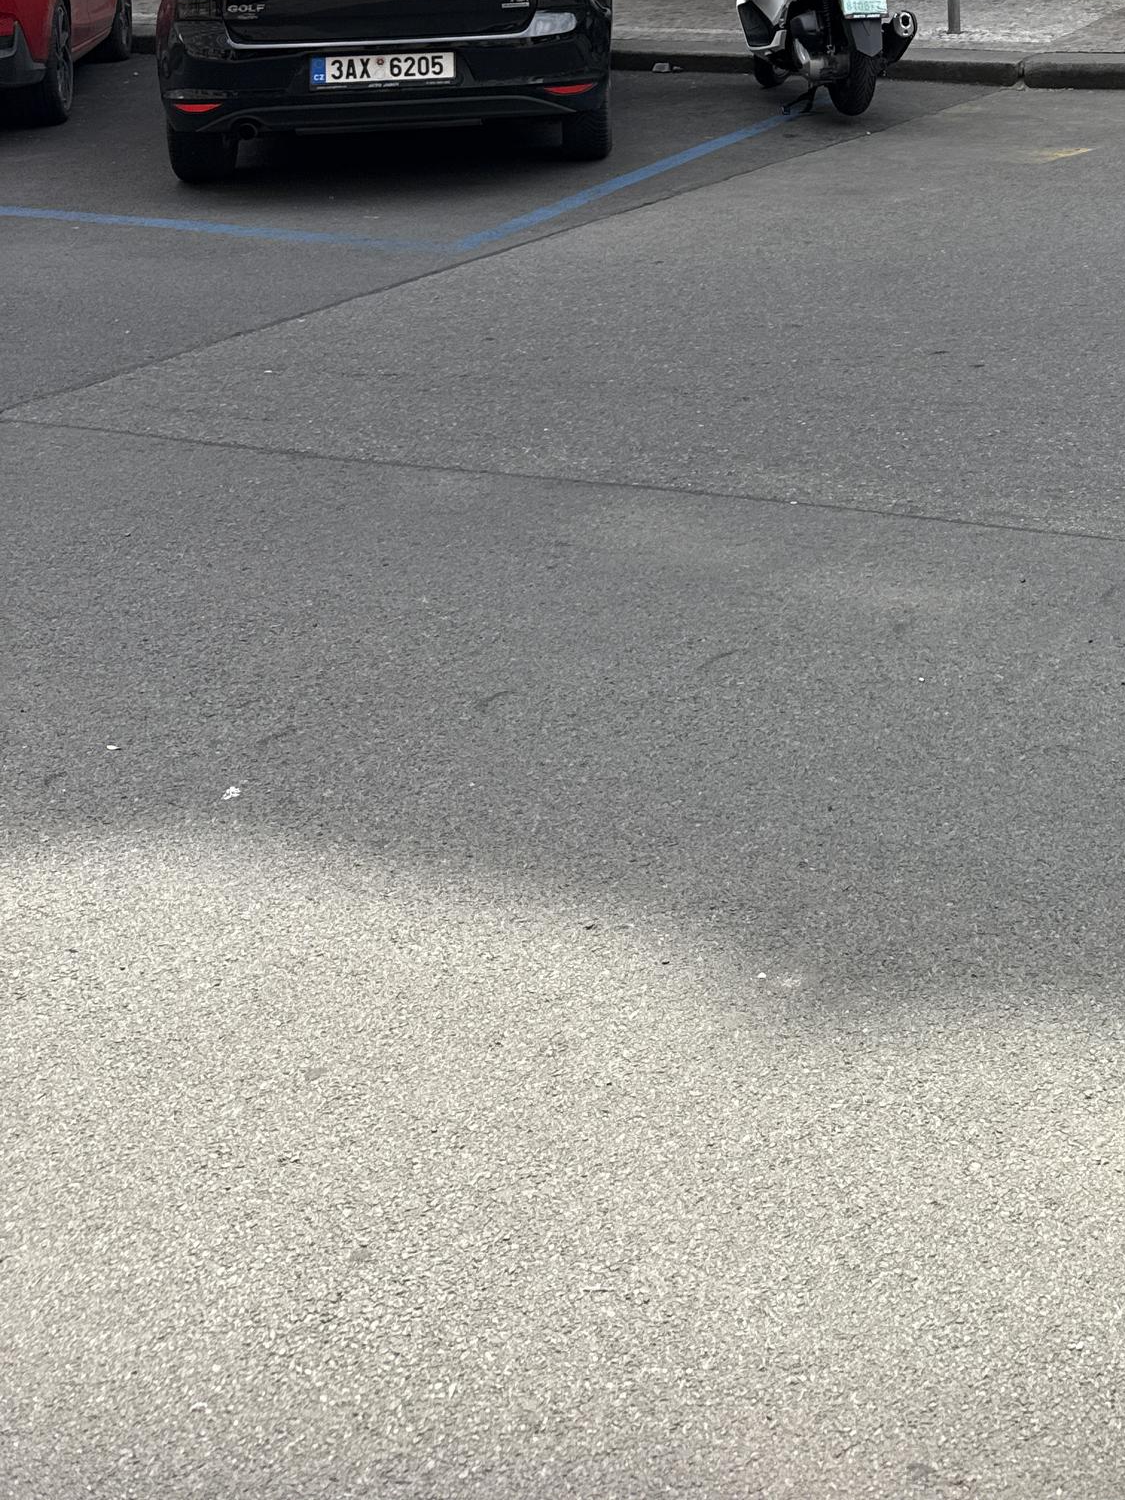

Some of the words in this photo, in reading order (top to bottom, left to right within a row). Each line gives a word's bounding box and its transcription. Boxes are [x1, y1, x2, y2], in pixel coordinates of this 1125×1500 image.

[227, 3, 266, 13] GOLF
[330, 57, 371, 80] 3AX
[389, 55, 444, 78] 6205
[313, 73, 325, 81] CZ
